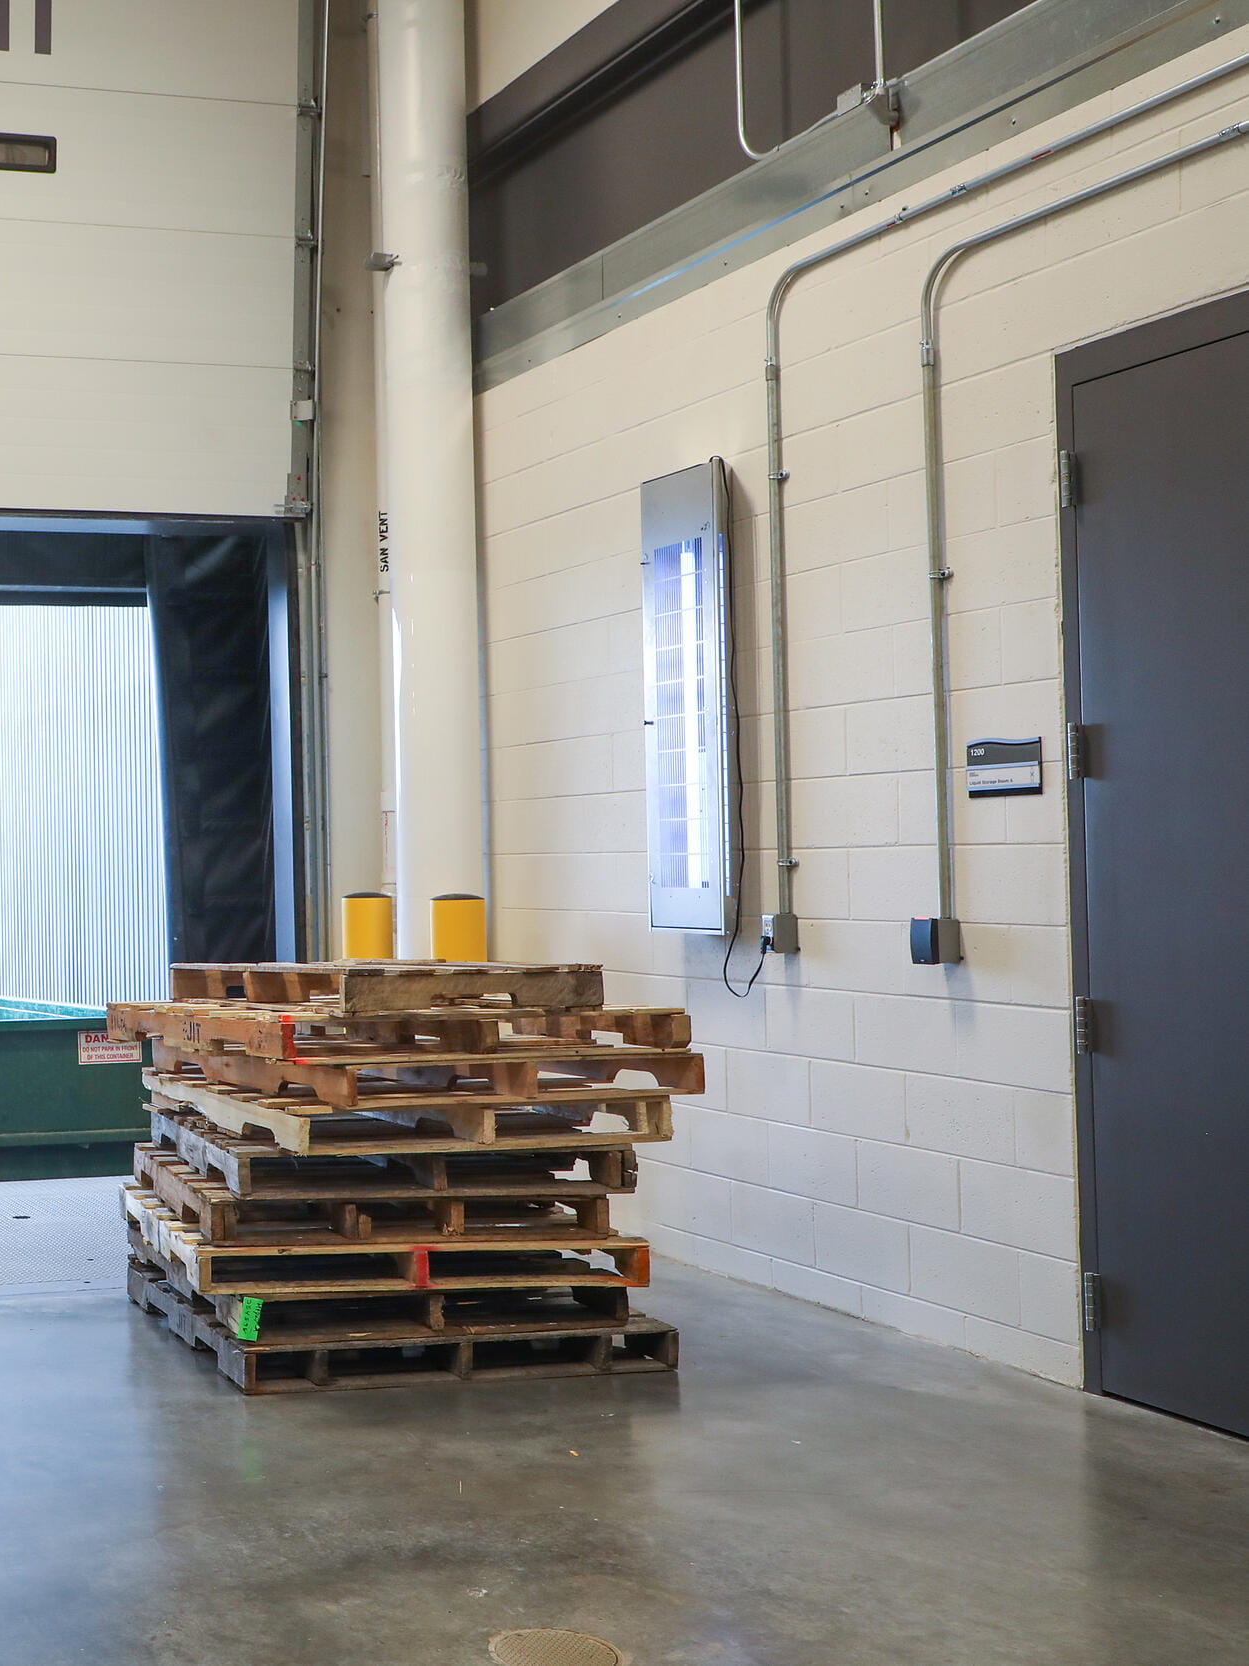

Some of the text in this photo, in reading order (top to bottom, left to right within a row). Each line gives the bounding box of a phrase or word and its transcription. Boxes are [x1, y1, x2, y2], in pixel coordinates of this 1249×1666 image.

[378, 510, 389, 573] SAN VENT
[970, 748, 985, 756] 1200
[84, 1034, 108, 1043] DAN
